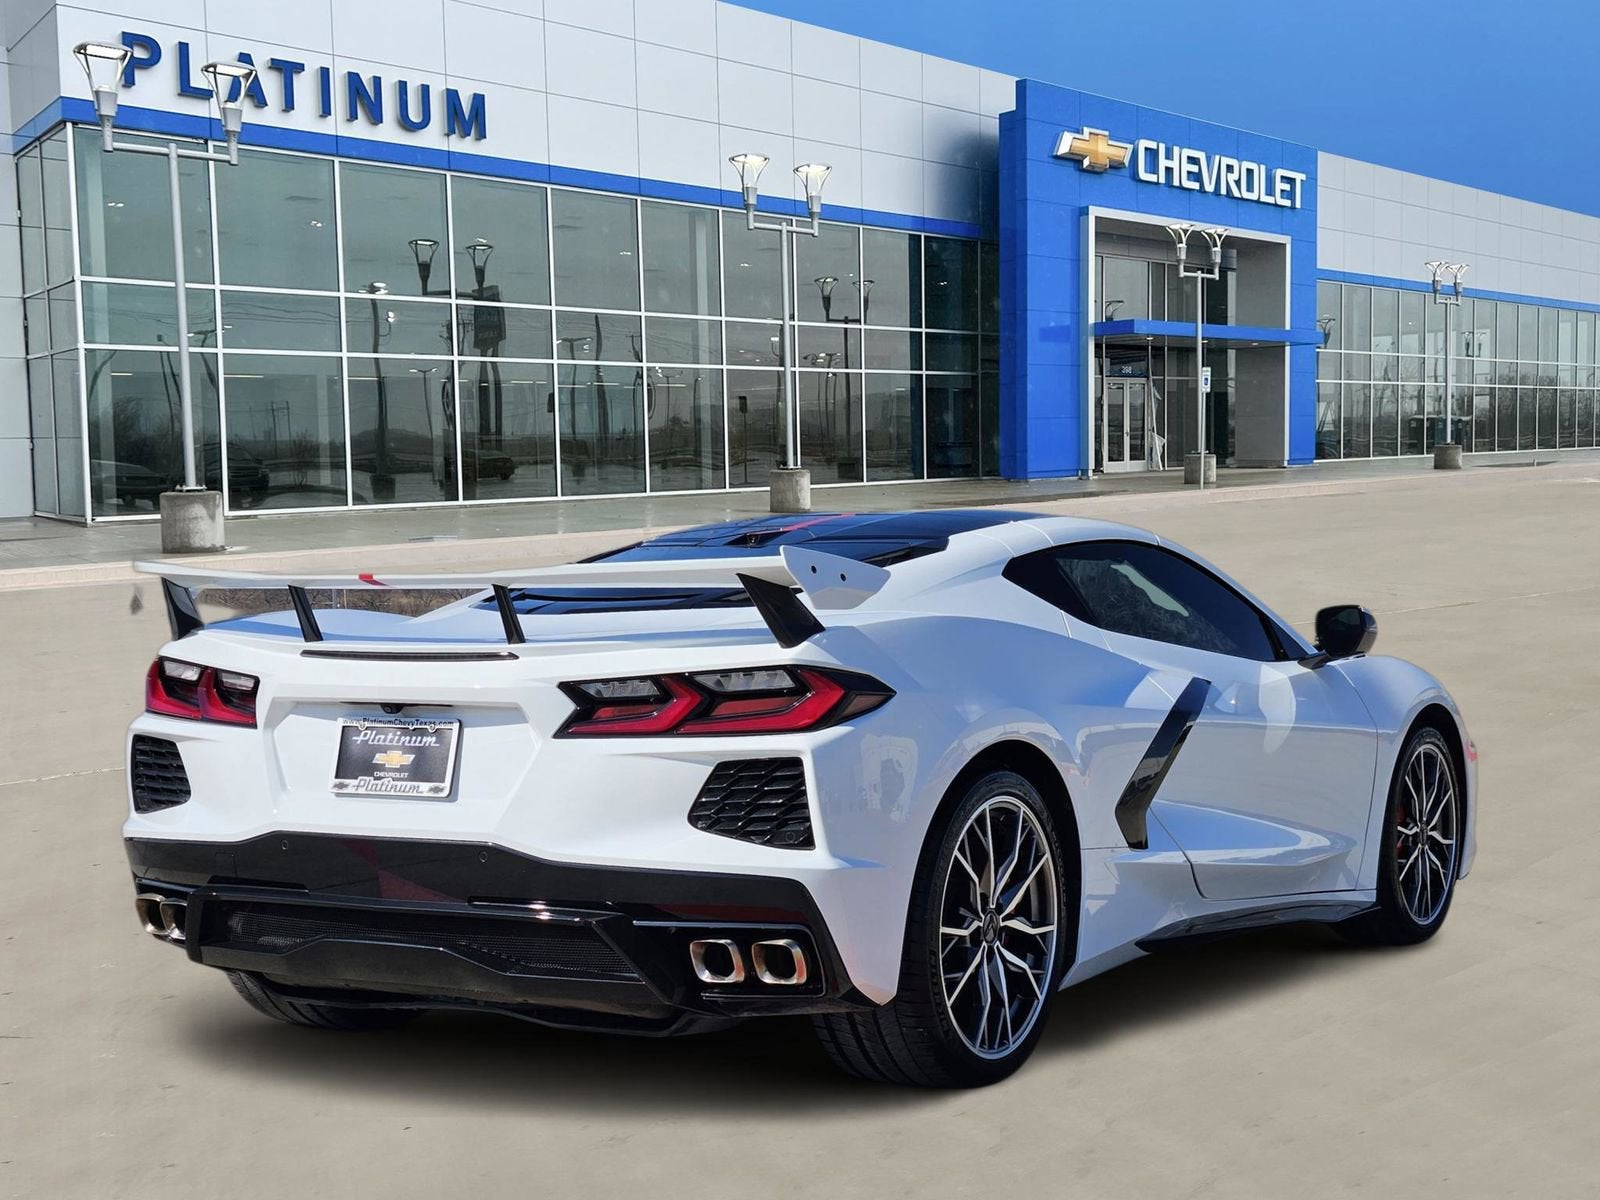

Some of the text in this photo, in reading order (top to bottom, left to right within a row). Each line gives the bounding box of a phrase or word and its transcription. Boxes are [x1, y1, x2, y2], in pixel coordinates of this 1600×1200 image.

[121, 31, 487, 140] PLATINUM
[1136, 138, 1307, 209] CHEVROLET
[352, 730, 440, 747] Platinum
[352, 778, 424, 794] Platinum
